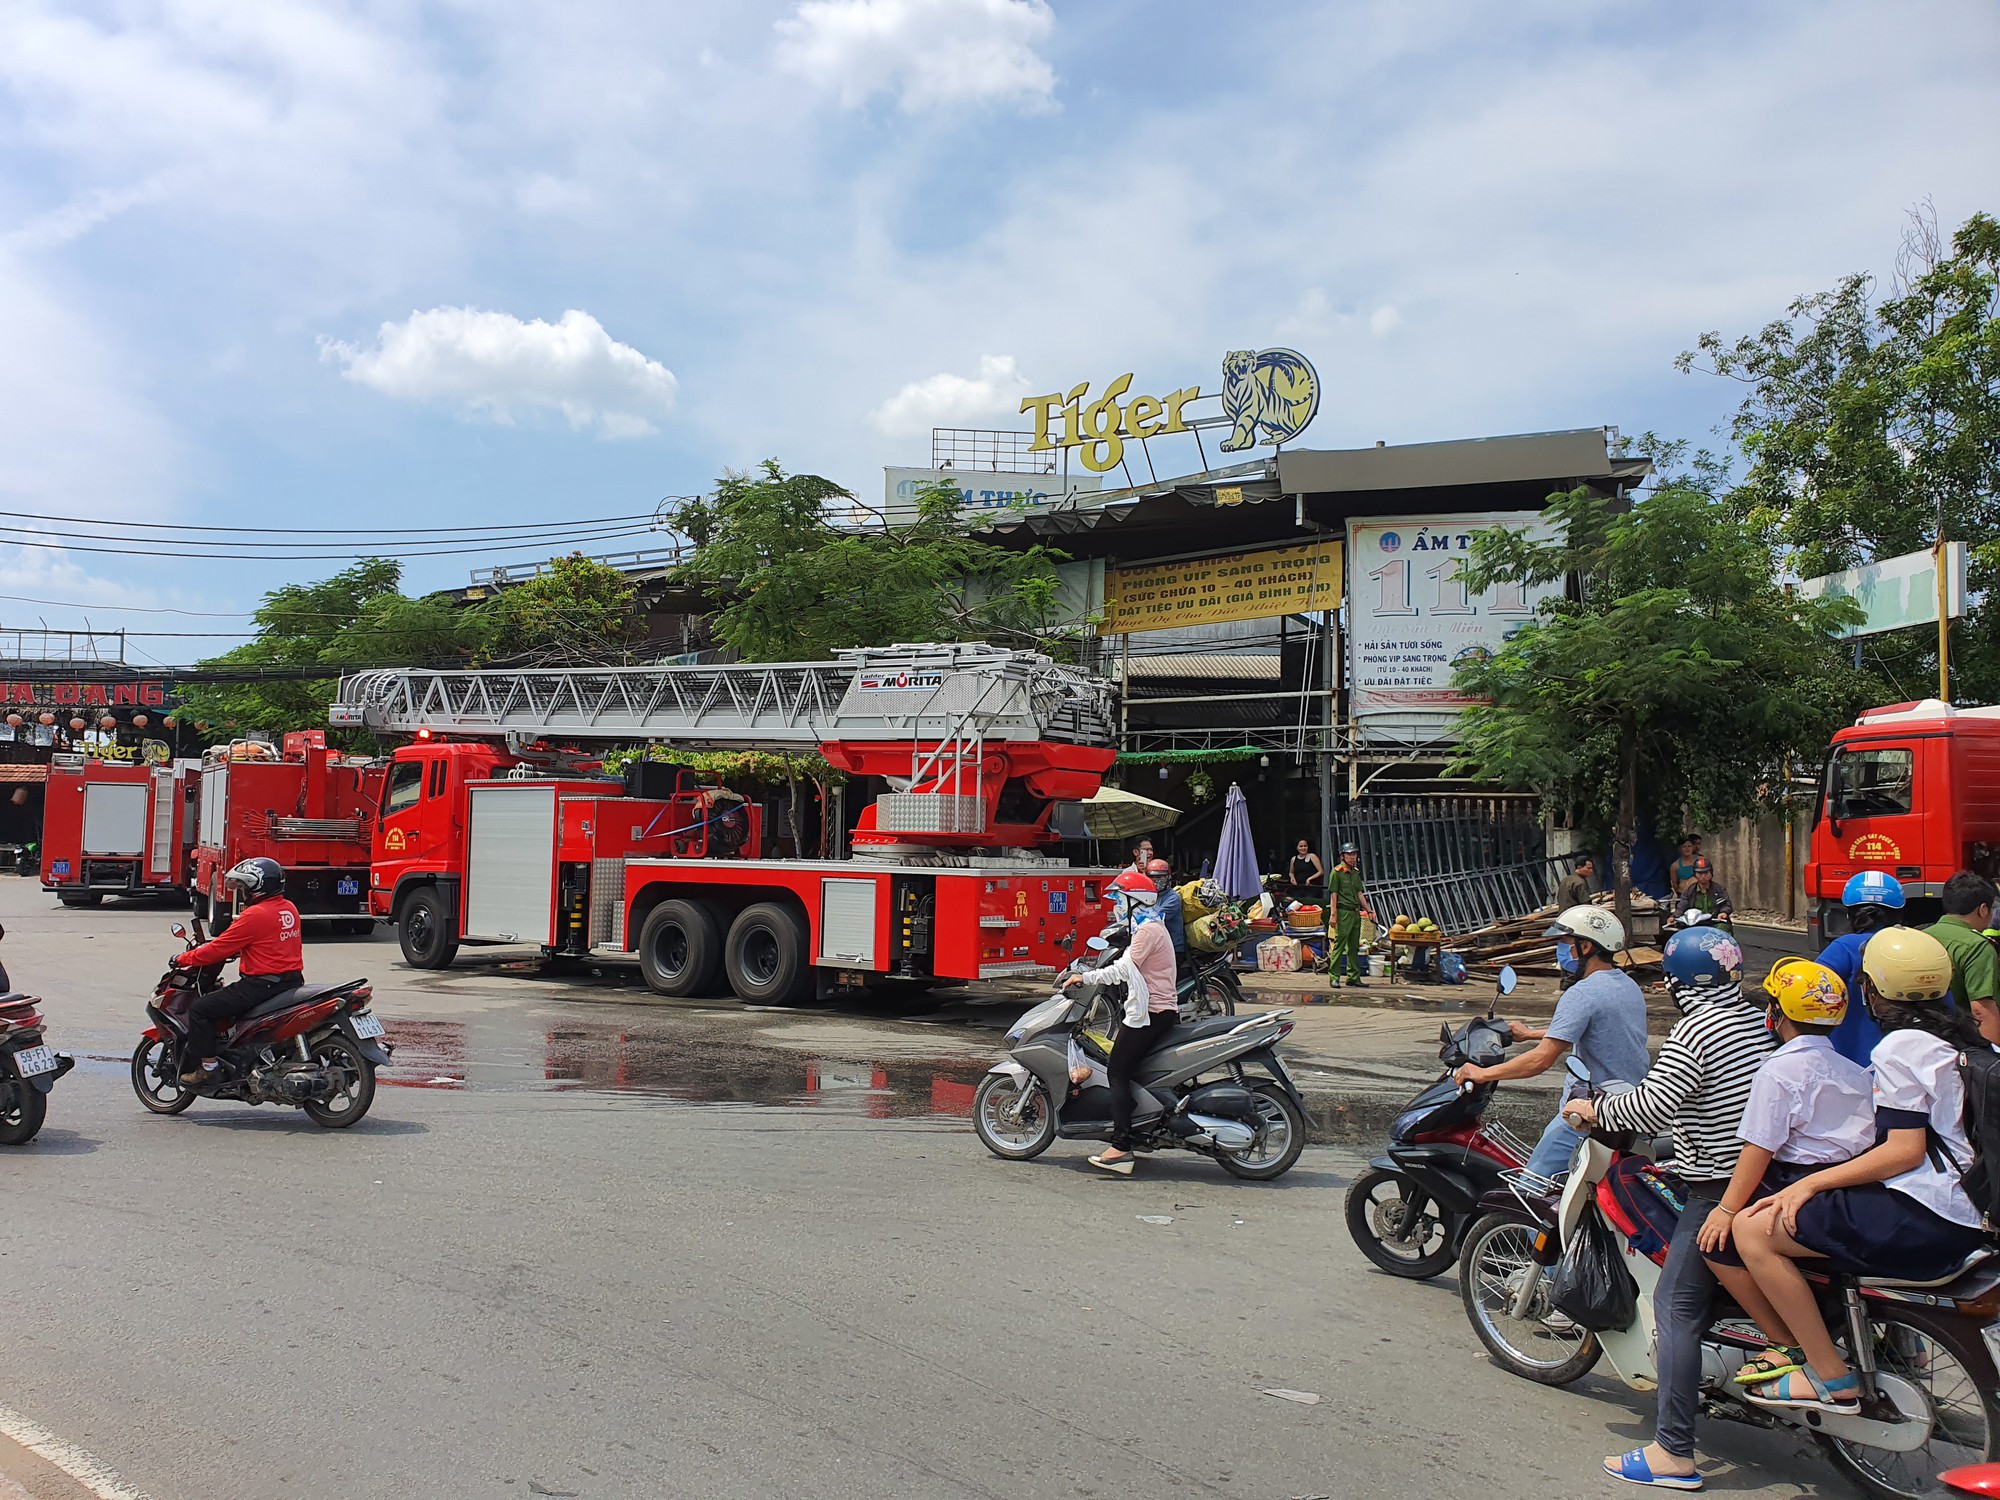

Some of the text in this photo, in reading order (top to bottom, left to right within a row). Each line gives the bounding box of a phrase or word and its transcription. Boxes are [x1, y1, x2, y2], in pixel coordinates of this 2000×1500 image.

[1020, 373, 1200, 472] Tiger
[1412, 527, 1449, 551] ẨM
[1183, 570, 1212, 582] VIP
[1217, 563, 1265, 578] SANG
[1271, 555, 1331, 570] TRỌNG
[1201, 583, 1216, 593] 10
[1234, 579, 1252, 589] 40
[1402, 654, 1421, 662] SANG
[882, 672, 942, 688] MORITA
[79, 738, 138, 761] Tiger
[1866, 842, 1882, 850] 114
[1014, 905, 1028, 917] 114
[20, 1048, 46, 1063] 59-F1
[22, 1058, 54, 1075] 446.23
